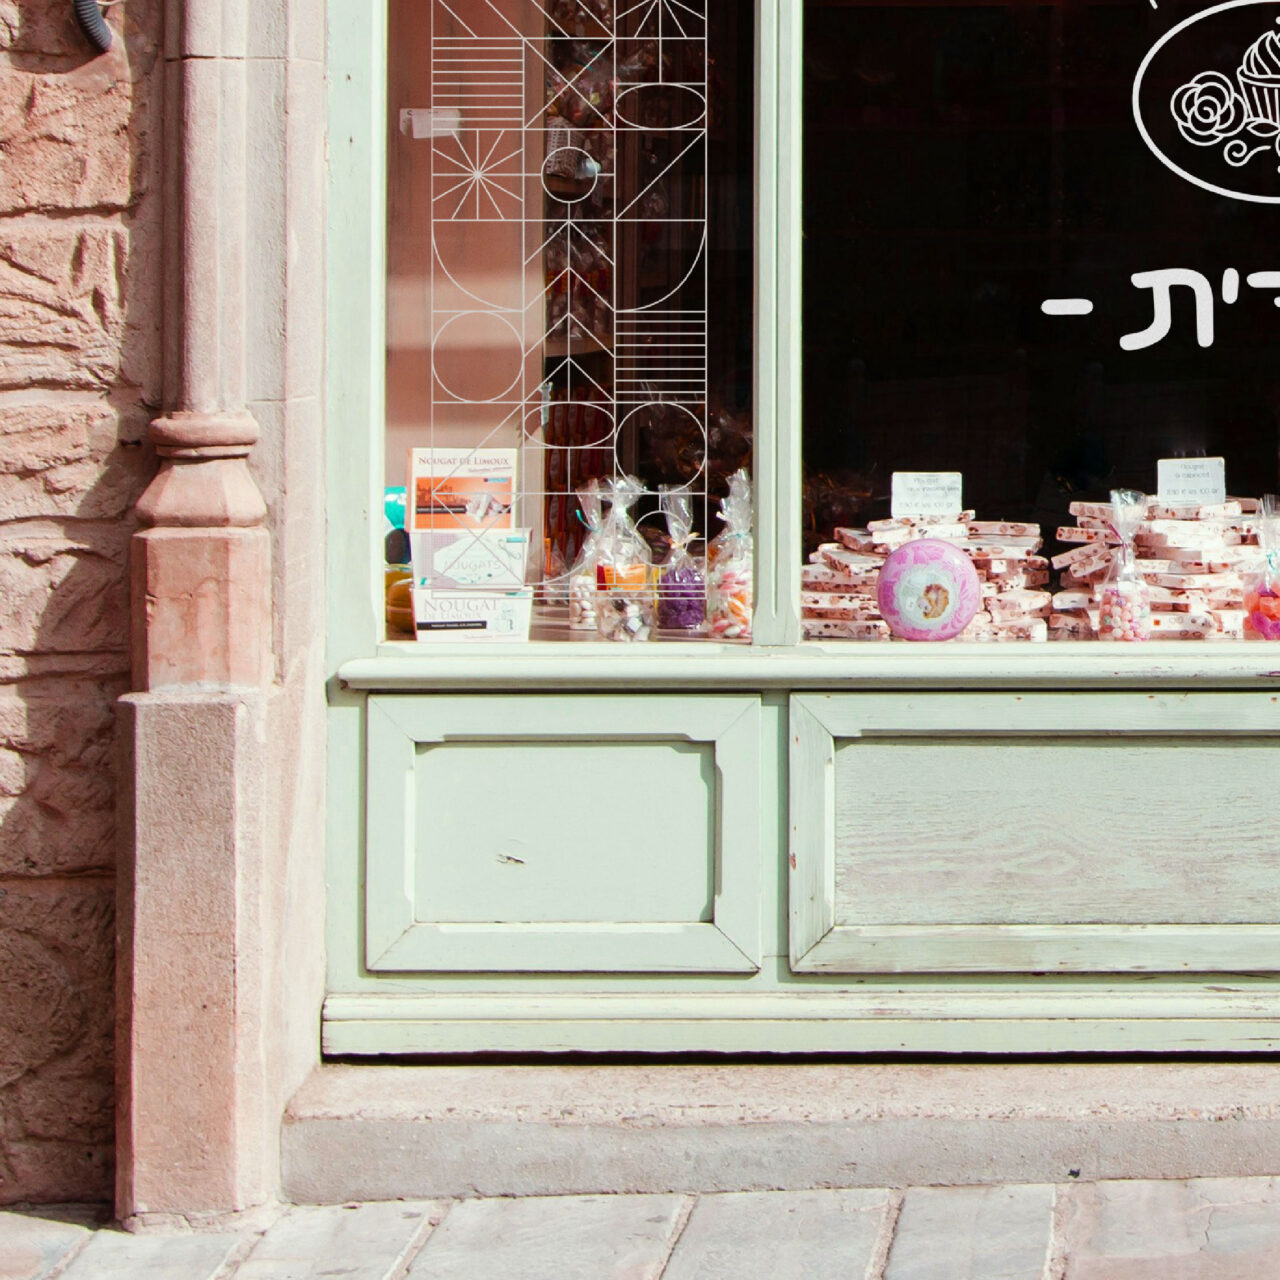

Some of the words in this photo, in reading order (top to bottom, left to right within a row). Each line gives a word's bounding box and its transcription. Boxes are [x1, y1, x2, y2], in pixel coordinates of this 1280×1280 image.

[418, 456, 457, 465] NOUGAT
[474, 456, 509, 465] LIMOUX
[424, 598, 498, 613] NOUGAT
